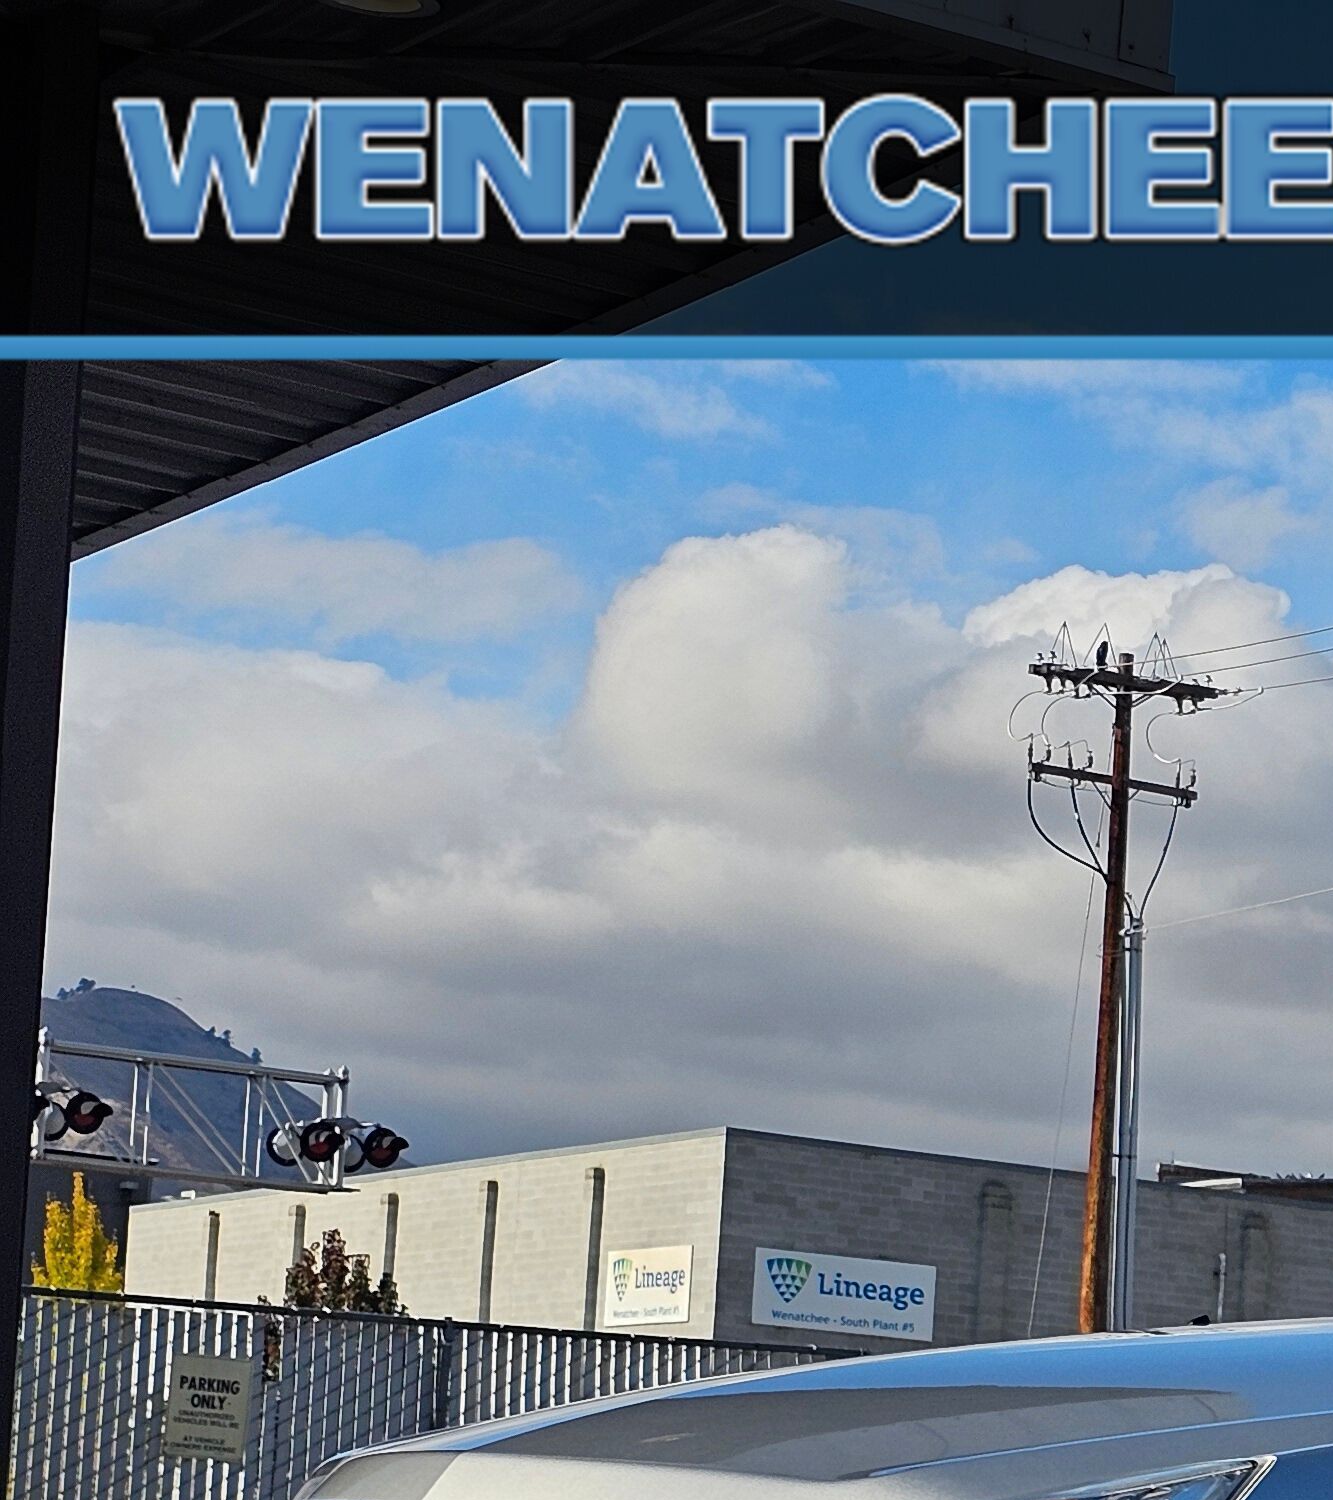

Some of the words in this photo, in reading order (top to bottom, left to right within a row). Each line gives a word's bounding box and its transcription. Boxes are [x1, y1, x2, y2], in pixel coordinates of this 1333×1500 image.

[635, 1265, 685, 1294] Lineage
[818, 1272, 925, 1311] Lineage
[772, 1309, 830, 1324] Wenatchee
[840, 1316, 870, 1328] South
[872, 1319, 899, 1332] Plant
[902, 1322, 915, 1333] #5
[180, 1375, 241, 1396] PARKING
[190, 1393, 227, 1410] ONLY
